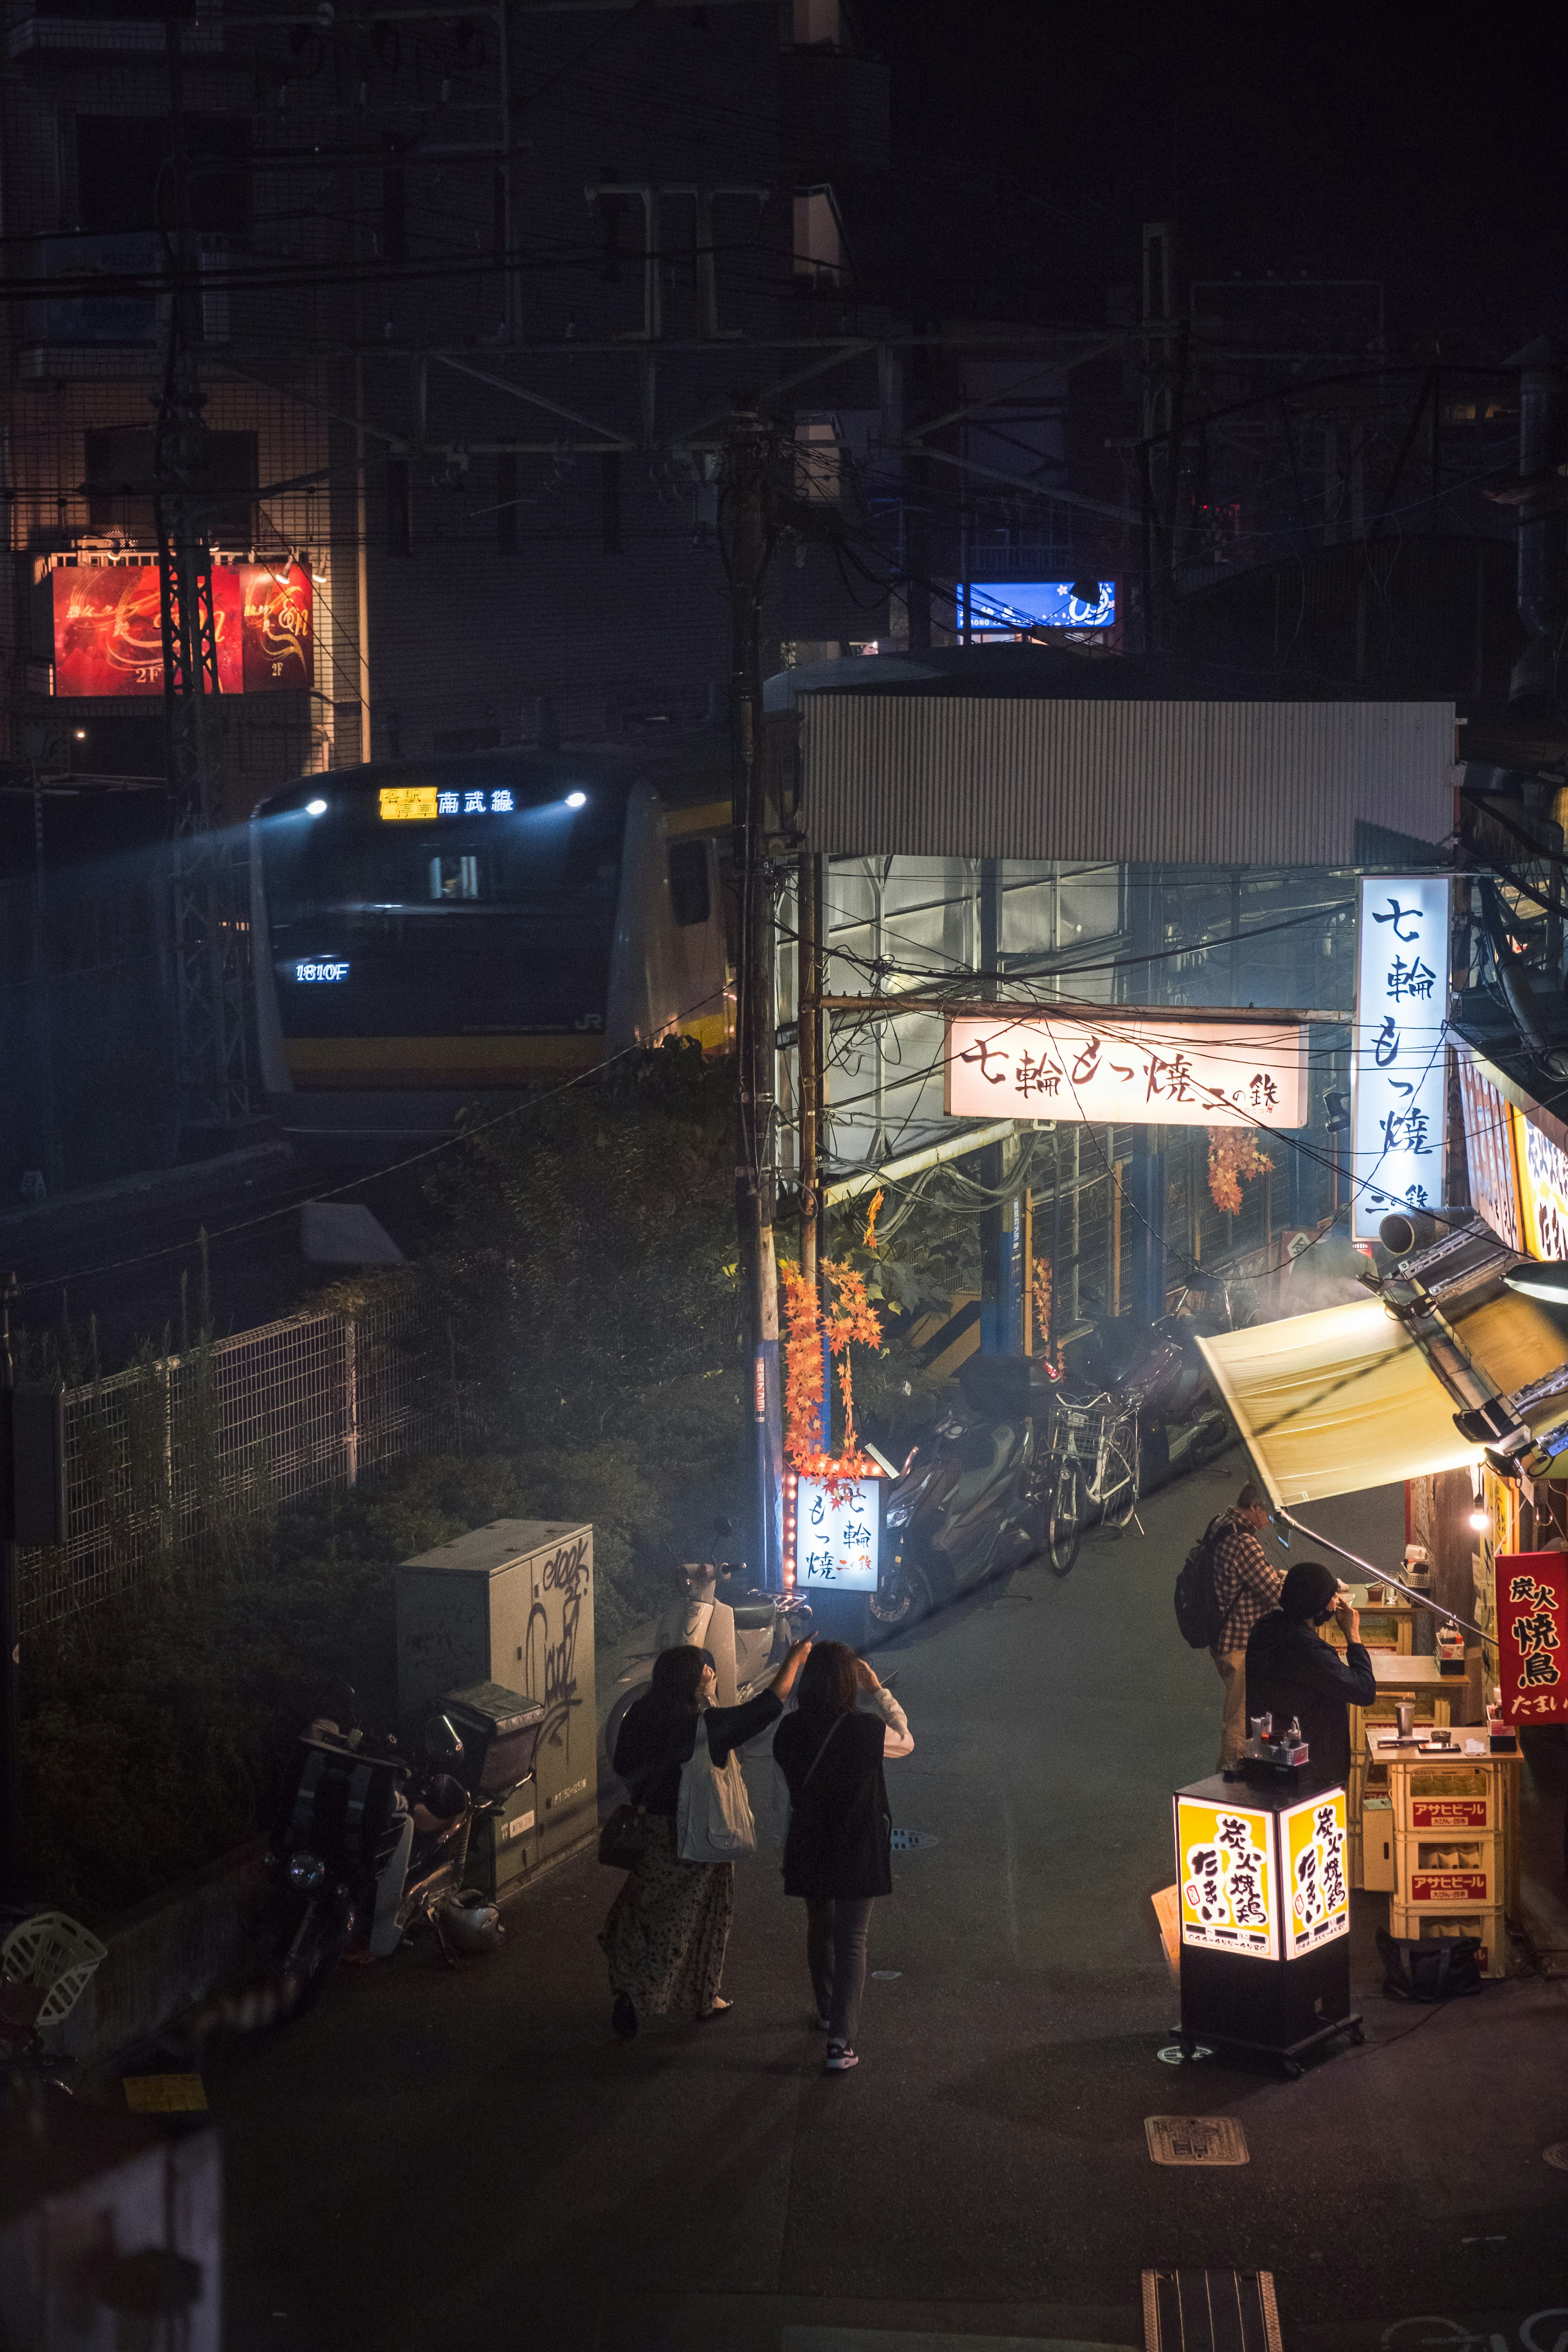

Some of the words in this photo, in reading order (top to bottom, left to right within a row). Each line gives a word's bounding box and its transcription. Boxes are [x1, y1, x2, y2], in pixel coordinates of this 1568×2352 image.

[136, 668, 163, 683] 2F
[272, 663, 283, 676] 2F
[437, 790, 513, 814] 南武線
[574, 1013, 602, 1030] JR
[806, 1495, 836, 1579] もつ焼
[1510, 1576, 1561, 1689] 炭火焼鳥
[1414, 1804, 1484, 1815] アサヒビール
[1414, 1877, 1484, 1889] アサヒビール
